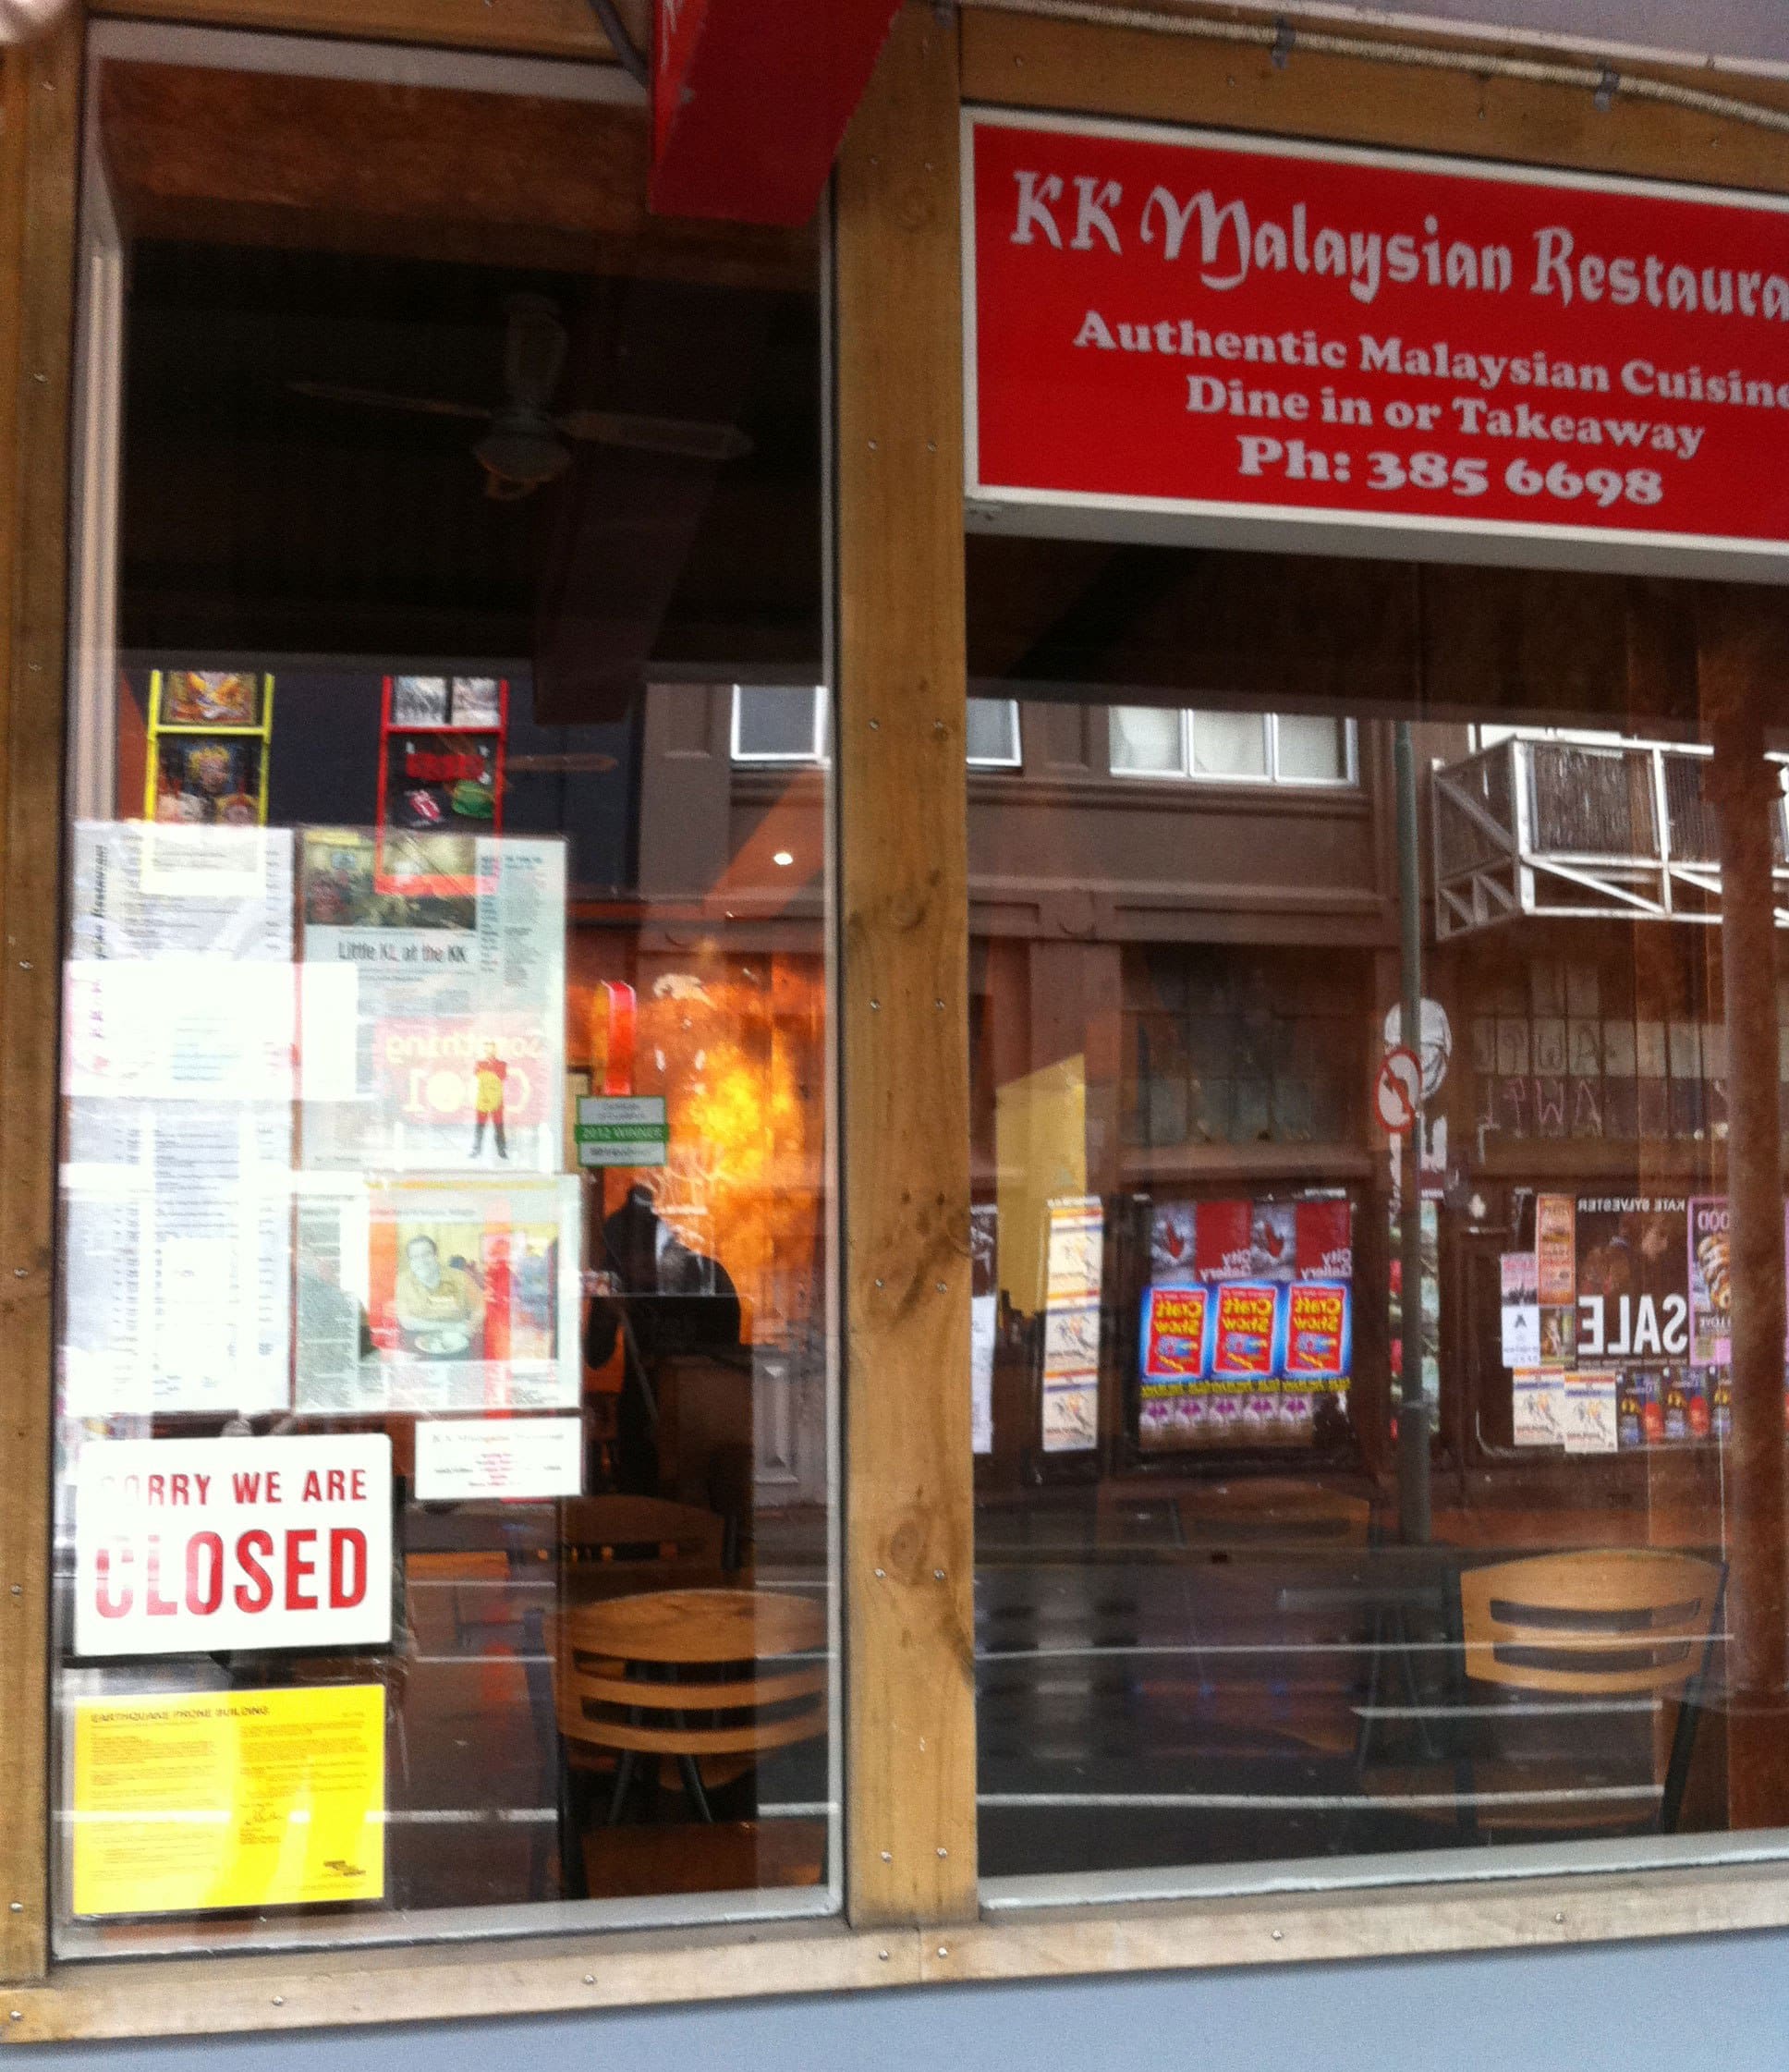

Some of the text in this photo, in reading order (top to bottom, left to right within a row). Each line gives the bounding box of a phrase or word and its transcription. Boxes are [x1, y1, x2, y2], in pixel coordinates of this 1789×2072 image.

[1010, 169, 1124, 254] KK
[1139, 185, 1513, 304] Malaysian
[1073, 310, 1348, 371] Authentic
[1358, 334, 1611, 391] Malaysian
[1186, 374, 1705, 460] Dine in or Takeaway
[1236, 434, 1664, 509] Ph: 385 6698
[232, 1470, 282, 1505] WE
[302, 1469, 367, 1503] ARE
[96, 1527, 369, 1618] CLOSED
